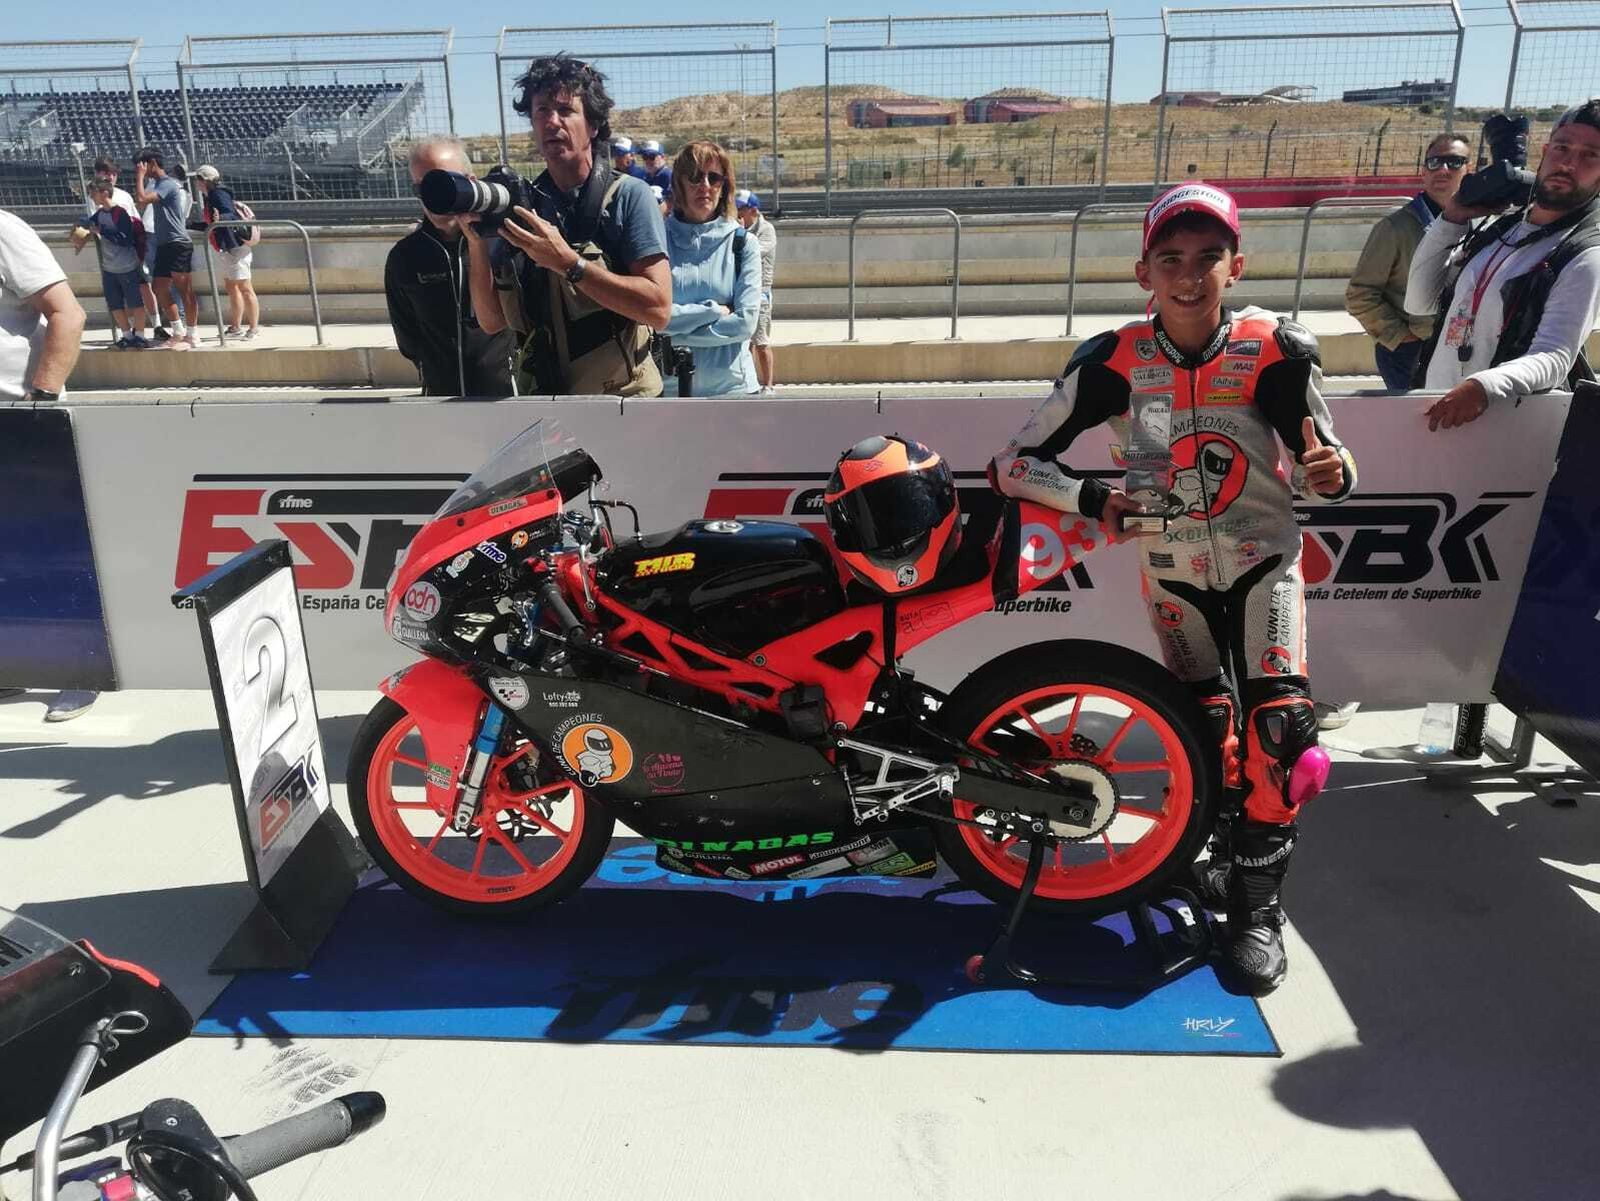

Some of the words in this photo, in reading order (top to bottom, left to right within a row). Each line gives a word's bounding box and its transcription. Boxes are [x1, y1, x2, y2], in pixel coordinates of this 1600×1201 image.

[302, 594, 360, 612] España
[1333, 587, 1388, 600] Cetelem
[1391, 587, 1408, 600] de
[1411, 587, 1482, 602] Superbike
[1267, 607, 1279, 642] CUNA
[243, 615, 298, 759] 2
[552, 713, 602, 742] CAMPEONES
[755, 855, 803, 874] MOTUL
